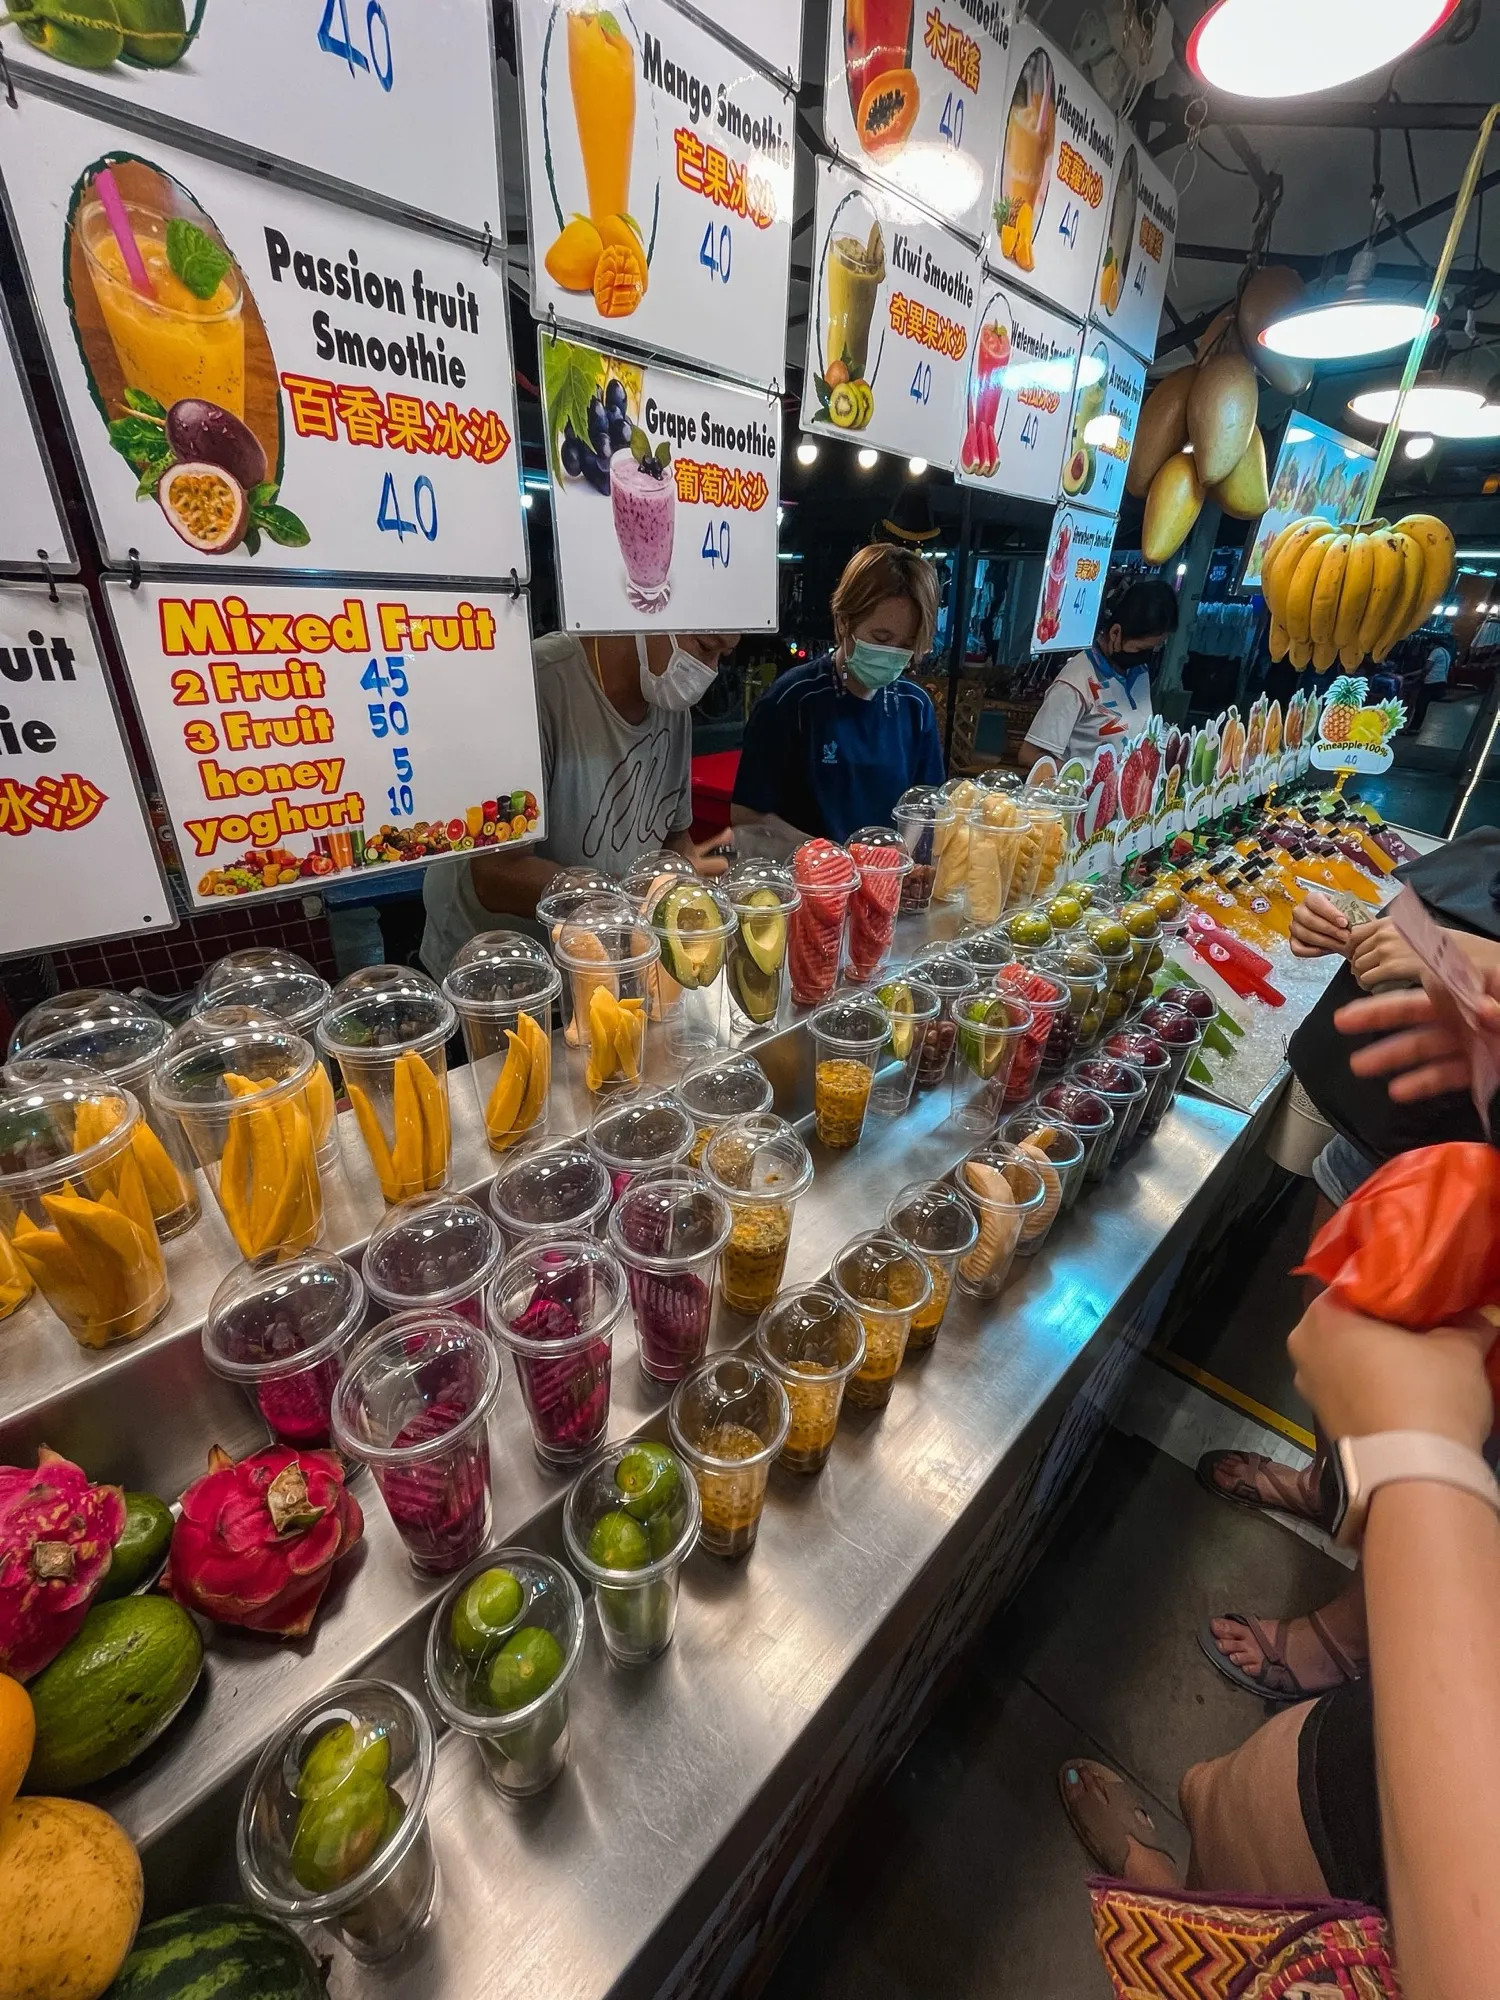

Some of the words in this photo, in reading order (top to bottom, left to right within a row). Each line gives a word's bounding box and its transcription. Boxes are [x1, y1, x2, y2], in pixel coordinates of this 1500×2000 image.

[318, 0, 393, 92] 40
[643, 32, 712, 124] Mango
[717, 83, 790, 169] Smoothie
[940, 92, 964, 151] 40
[1056, 83, 1089, 143] Pineapple
[1089, 117, 1114, 169] Smoothie
[700, 221, 732, 283] 40
[1059, 201, 1079, 249] 40
[263, 226, 406, 315] Passion
[412, 269, 479, 334] fruit
[892, 233, 922, 277] Kiwi
[923, 253, 974, 309] Smoothie
[1134, 261, 1147, 297] 40
[312, 310, 466, 388] Smoothie
[889, 291, 968, 361] 奇異果冰沙
[1011, 320, 1049, 360] Watermelon
[910, 361, 932, 405] 40
[1108, 364, 1133, 398] Avocado
[281, 372, 511, 464] 百香果冰沙
[645, 397, 697, 448] Grape
[700, 411, 776, 458] Smoothie
[1020, 413, 1038, 450] 40
[674, 457, 769, 512] 葡萄冰沙
[1102, 462, 1113, 491] 40
[376, 471, 438, 543] 40
[702, 520, 731, 570] 40
[158, 596, 370, 655] Mixed
[377, 602, 495, 651] Fruit
[1074, 587, 1086, 614] 40
[171, 670, 209, 706] 2
[208, 658, 326, 703] Fruit
[360, 656, 409, 698] 45
[184, 720, 219, 754] 3
[221, 705, 334, 750] Fruit
[368, 701, 409, 738] 50
[1317, 740, 1365, 753] Pineapple
[1364, 742, 1388, 757] 100%
[199, 758, 345, 800] honey
[393, 747, 413, 783] 5
[1344, 754, 1357, 765] 40
[184, 792, 364, 856] yoghurt
[388, 785, 414, 816] 10
